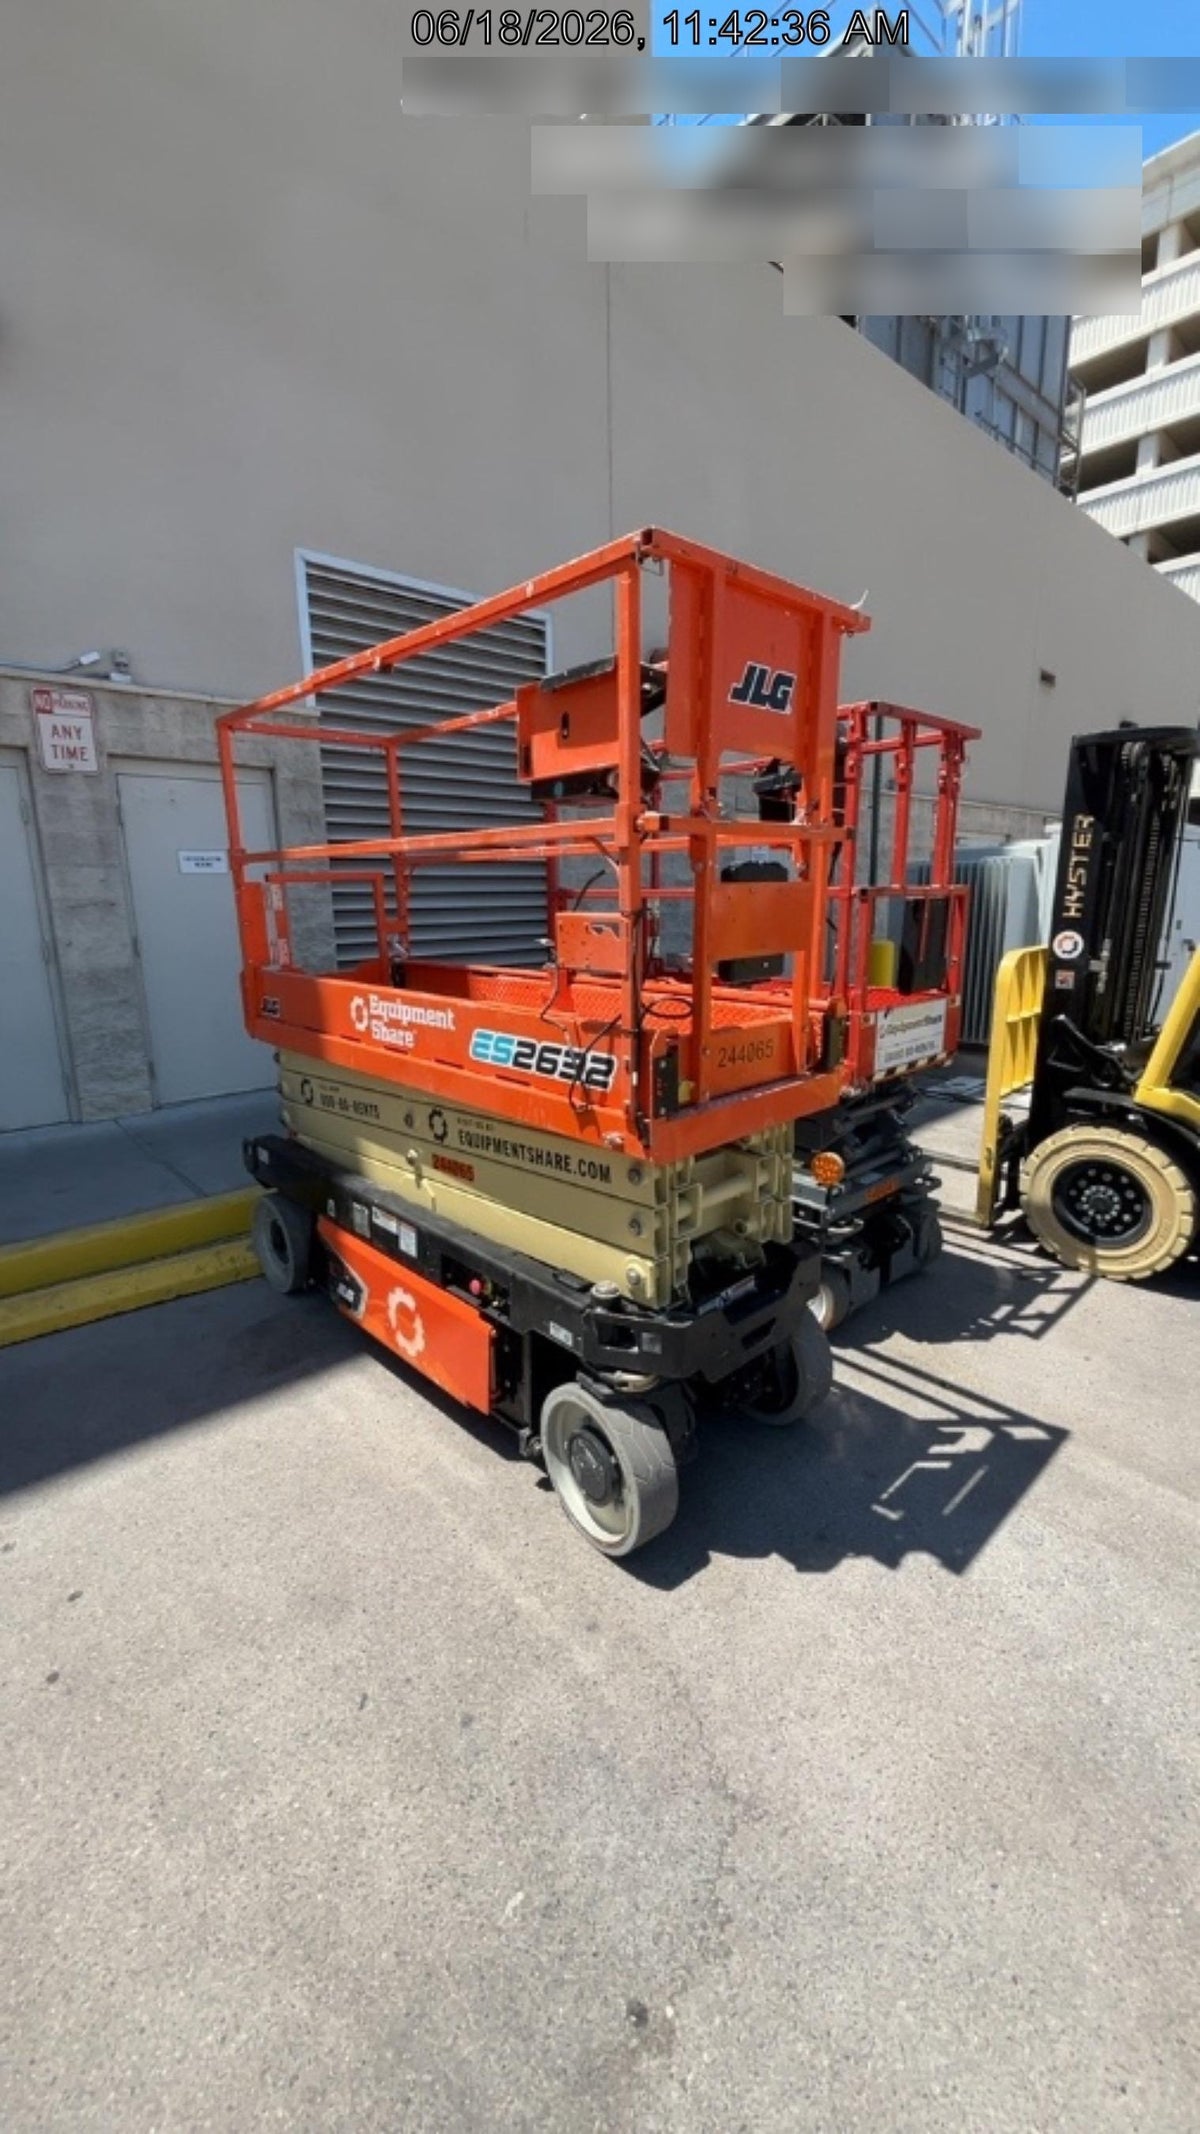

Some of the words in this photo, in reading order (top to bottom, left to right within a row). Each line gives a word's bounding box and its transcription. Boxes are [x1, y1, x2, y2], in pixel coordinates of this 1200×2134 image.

[729, 662, 796, 715] JLG
[51, 724, 82, 740] ANY
[50, 744, 89, 762] TIME
[1062, 813, 1095, 918] HYSTER
[369, 994, 456, 1031] Equipment
[371, 1020, 415, 1049] Share
[470, 1029, 617, 1092] ES2632
[717, 1039, 774, 1068] 244065
[458, 1129, 612, 1184] EQUIPMENTSHARE.COM
